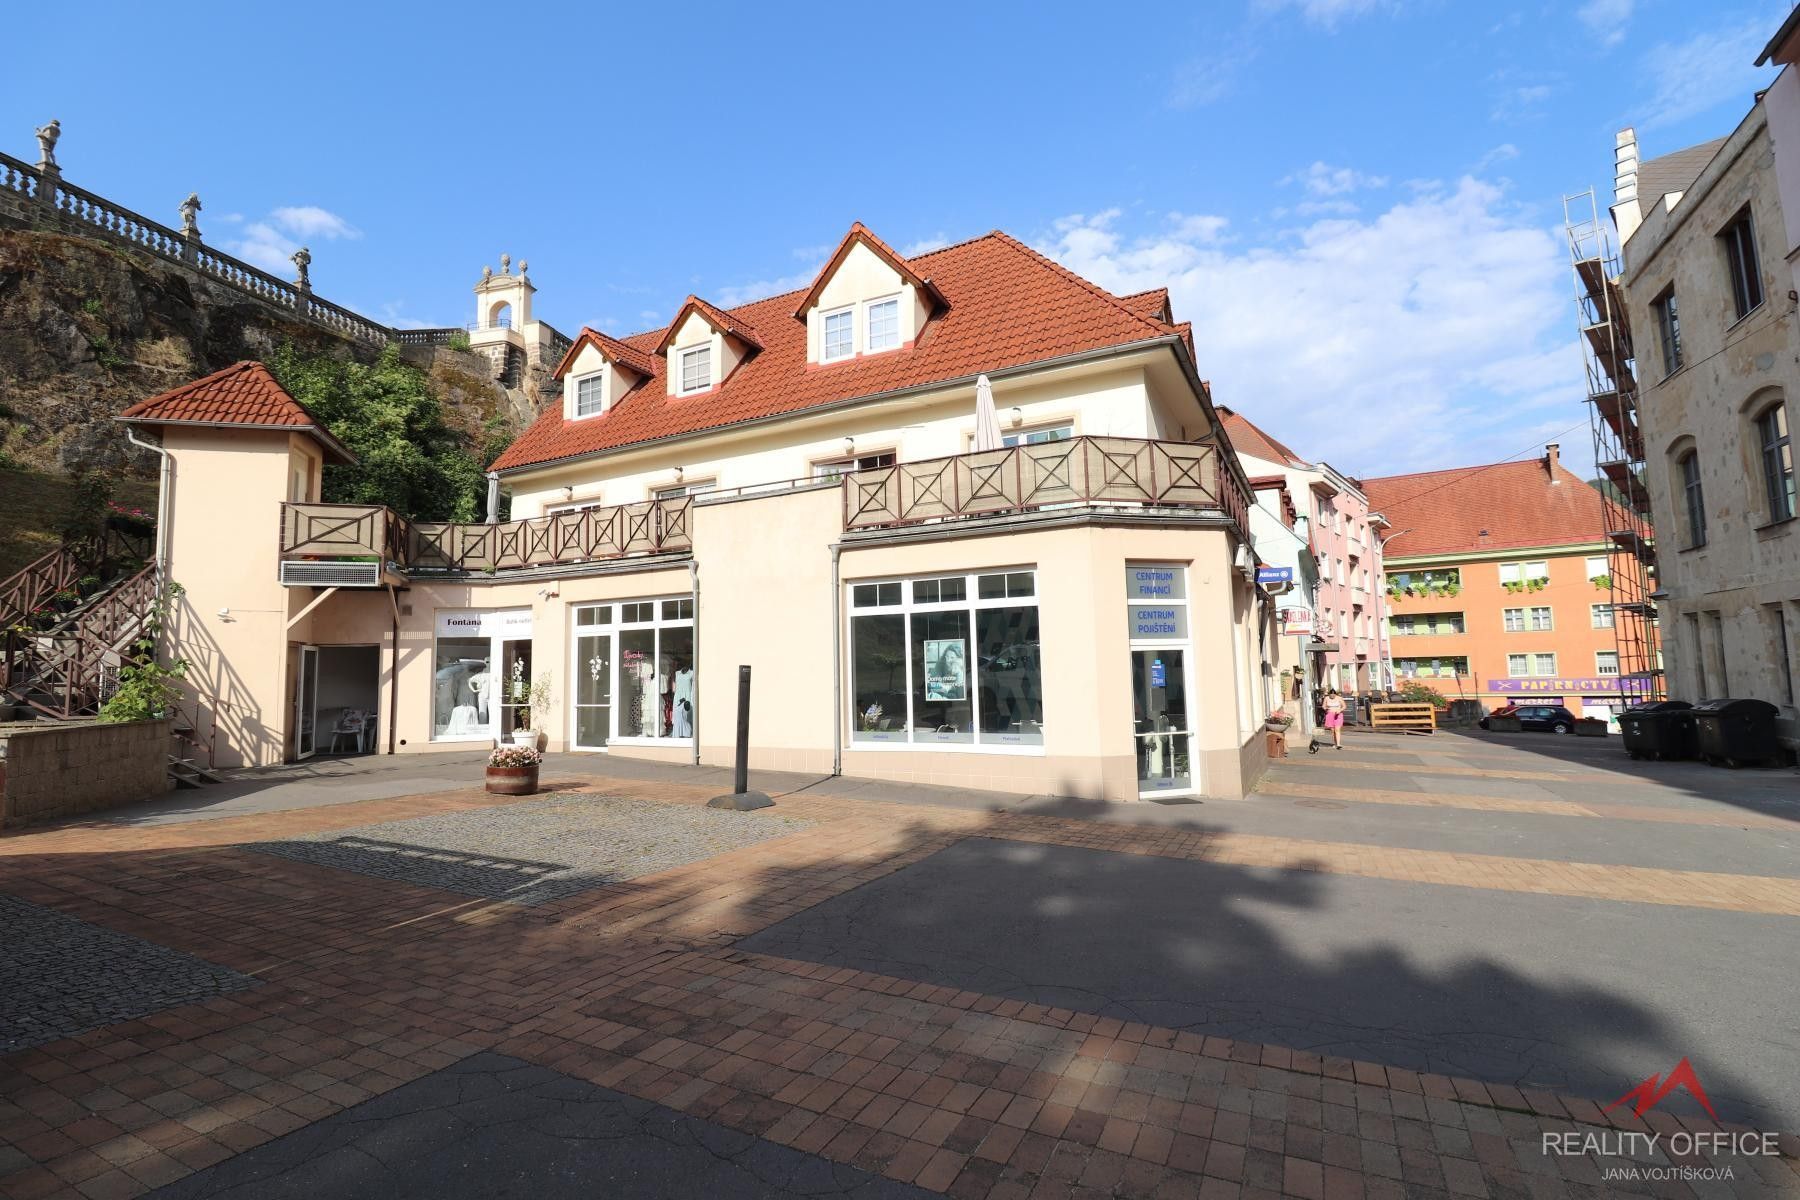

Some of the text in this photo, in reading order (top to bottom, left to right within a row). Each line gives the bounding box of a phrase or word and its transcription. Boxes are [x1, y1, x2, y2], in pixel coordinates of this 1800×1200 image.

[1136, 571, 1173, 581] CENTRUM
[1139, 583, 1171, 595] FINANCÍ
[1137, 610, 1175, 620] CENTRUM
[447, 618, 482, 626] Fontana
[1138, 622, 1176, 633] POJIŠTĚNÍ
